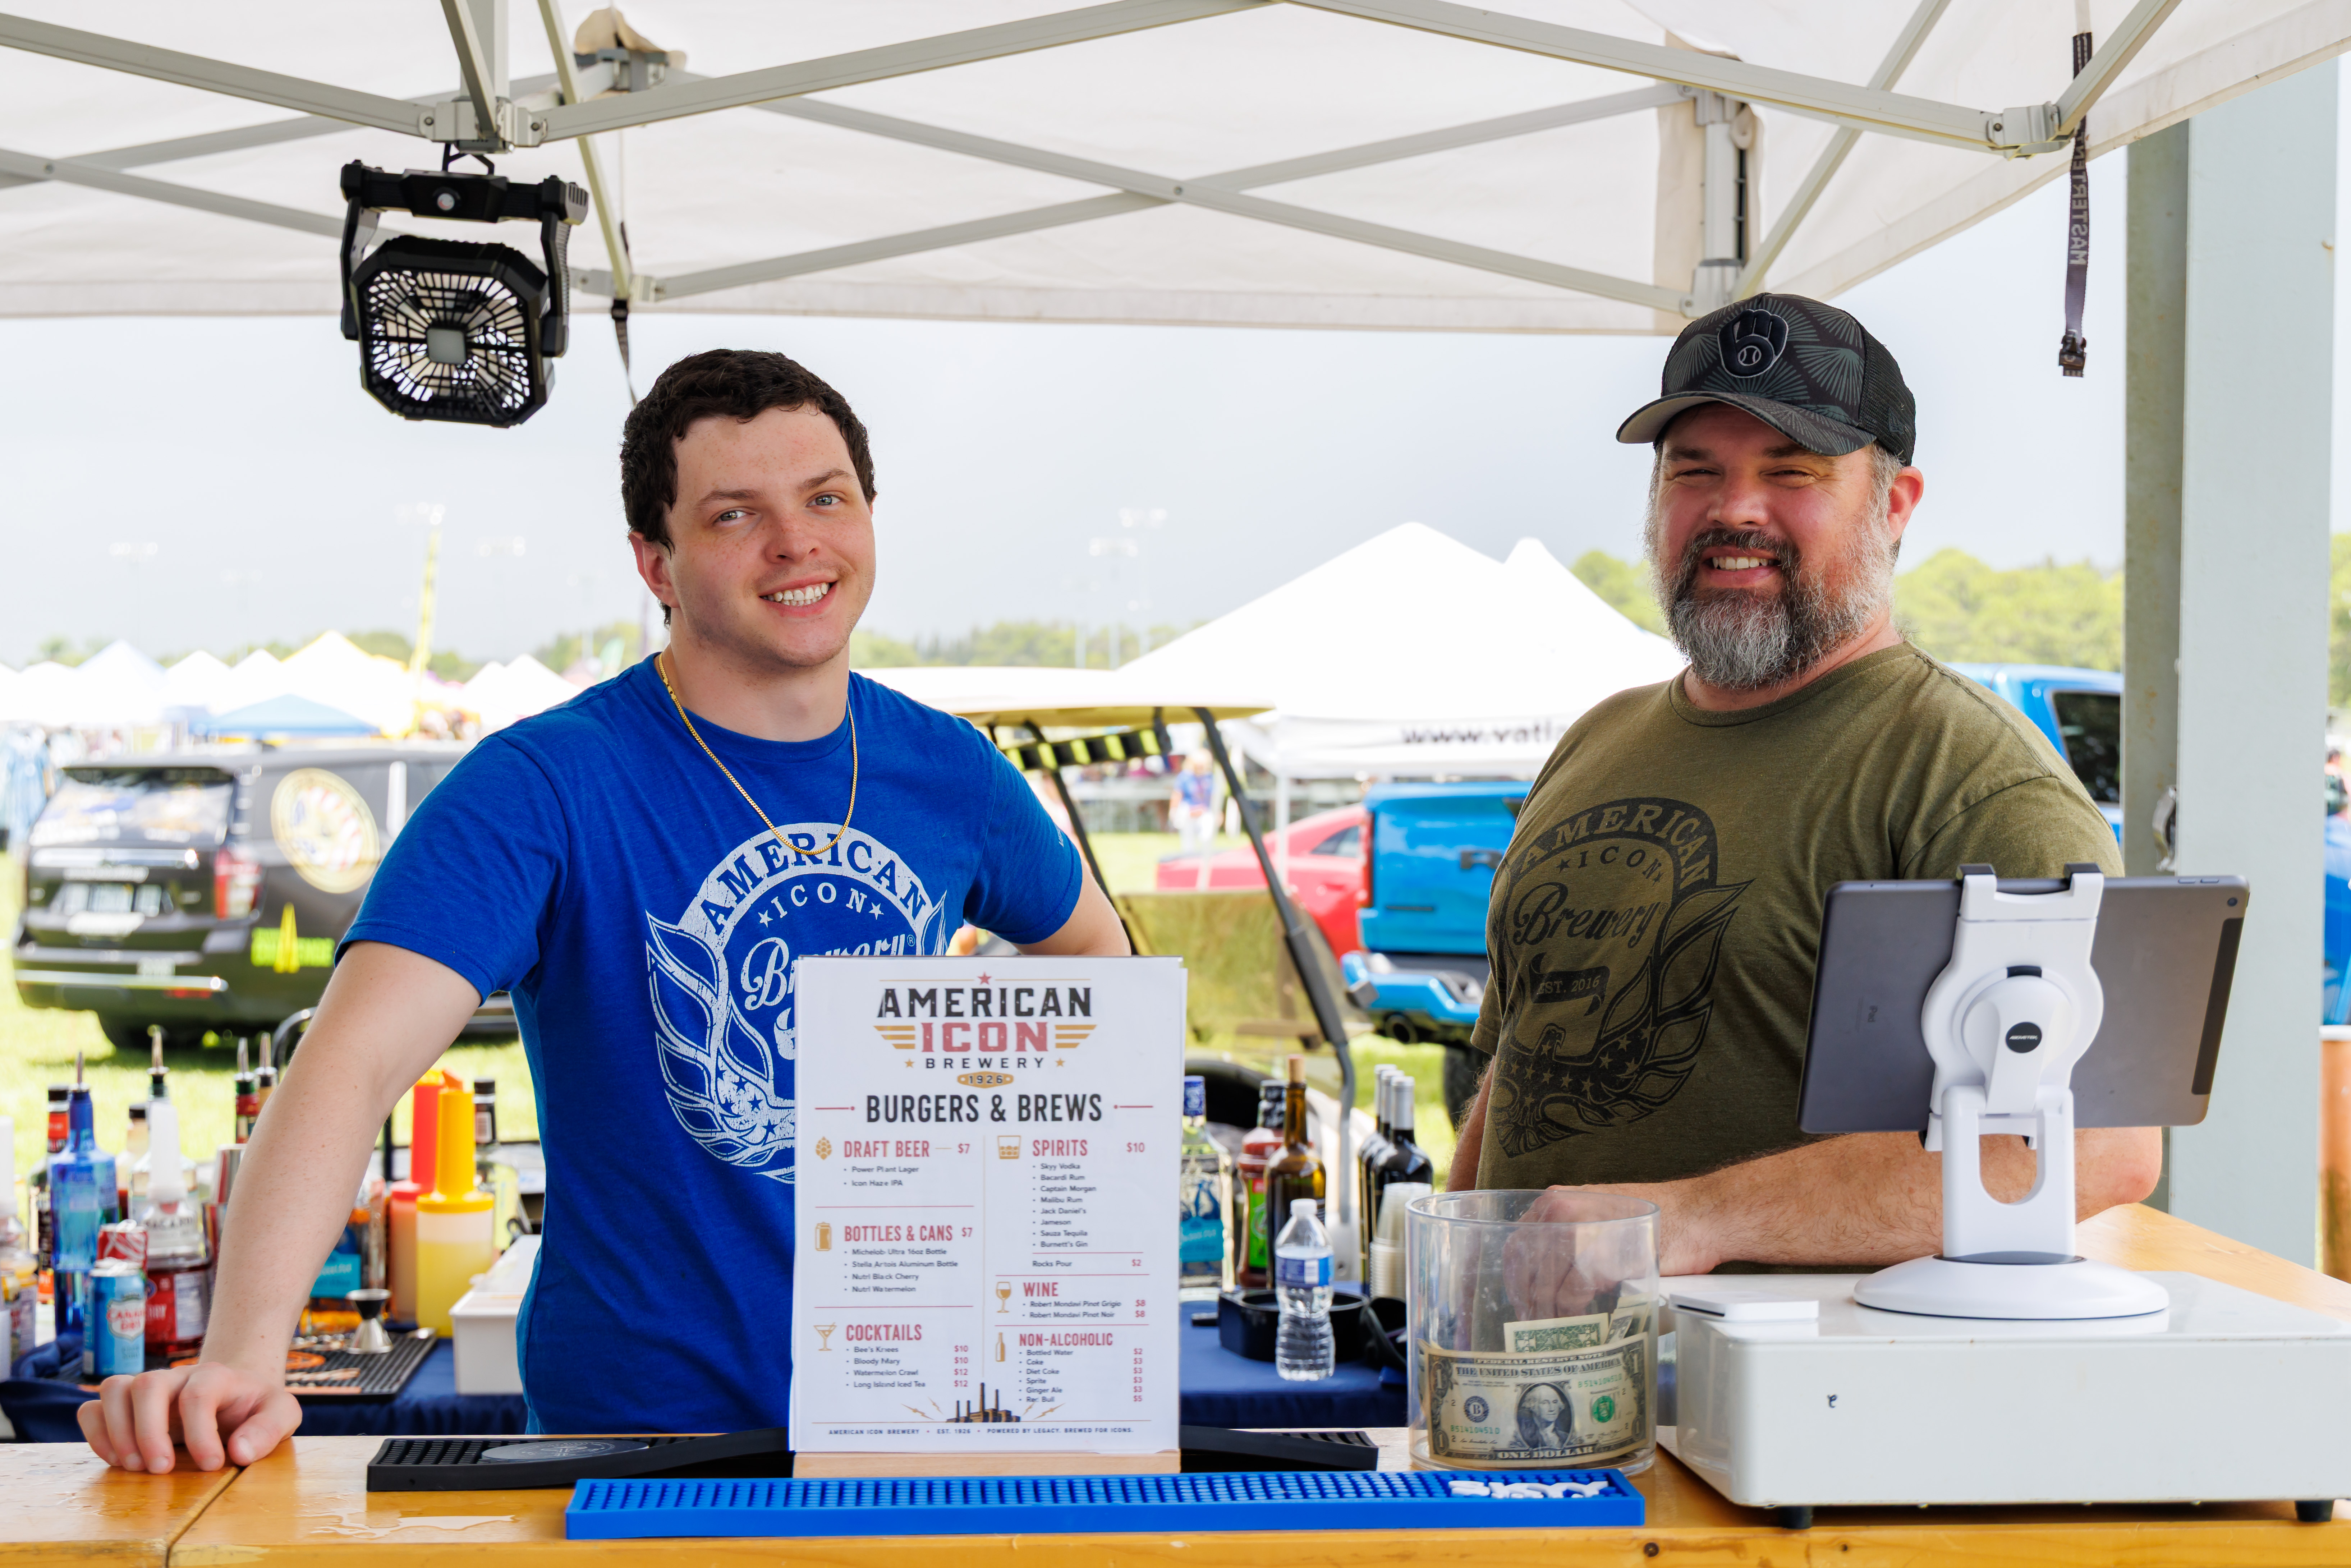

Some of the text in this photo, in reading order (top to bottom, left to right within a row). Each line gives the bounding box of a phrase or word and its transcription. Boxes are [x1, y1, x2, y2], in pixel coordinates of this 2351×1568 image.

[1518, 804, 1710, 888] AMERICAN
[1579, 846, 1661, 880] ICON
[700, 833, 926, 935] AMERICAN
[773, 882, 866, 918] ICON
[1513, 882, 1661, 948] Brewery
[1538, 976, 1599, 994] EST. 2016
[876, 987, 1092, 1018] AMERICAN
[921, 1022, 1048, 1052] ICON
[925, 1058, 1044, 1070] BREWERY
[969, 1075, 1004, 1084] 1926
[867, 1093, 1102, 1123] BURGERS & BREWS
[844, 1140, 970, 1157] DRAFT BEER $7
[1033, 1139, 1145, 1157] SPIRITS $10
[845, 1226, 973, 1241] BOTTLES & CANS $7
[1023, 1282, 1059, 1296] WINE
[846, 1324, 922, 1341] COCKTAILS
[1020, 1333, 1113, 1346] NON-ALCOHOLIC
[1456, 1357, 1621, 1376] THE UNITED STATES OF AMERICA
[1473, 1404, 1481, 1414] B
[1532, 1446, 1593, 1458] DOLLAR
